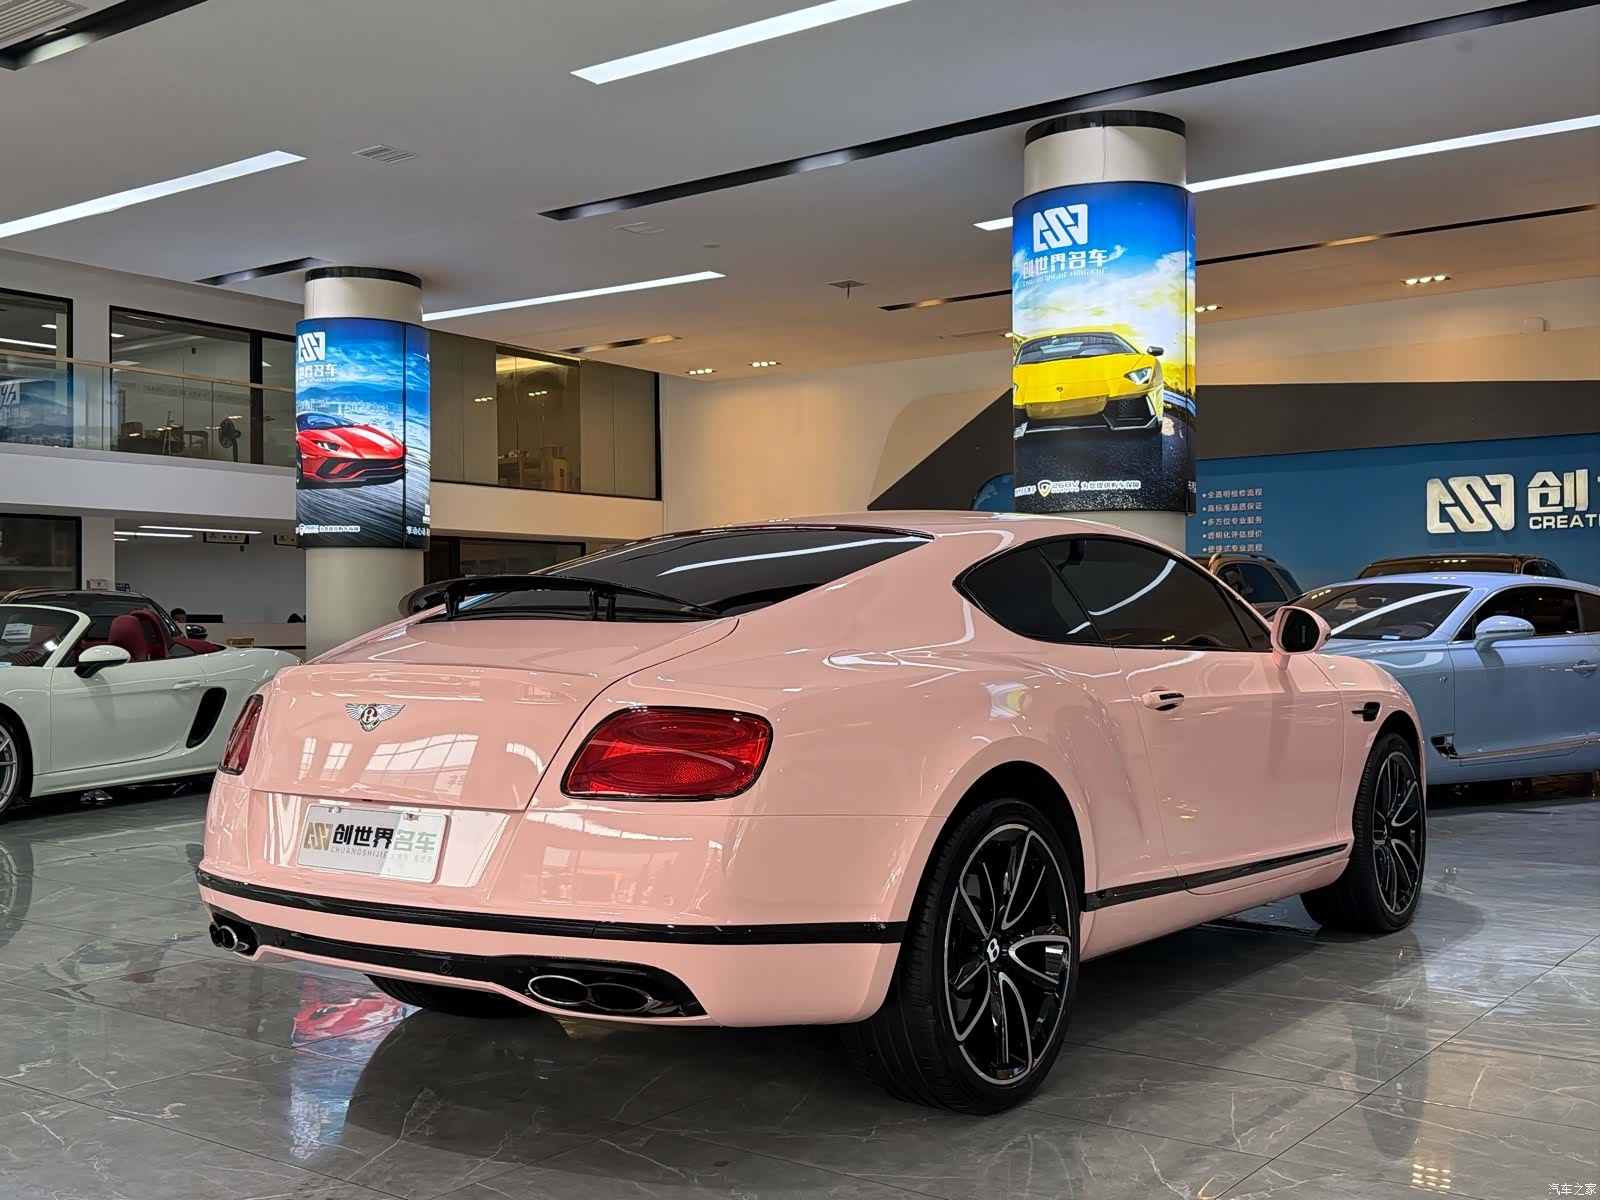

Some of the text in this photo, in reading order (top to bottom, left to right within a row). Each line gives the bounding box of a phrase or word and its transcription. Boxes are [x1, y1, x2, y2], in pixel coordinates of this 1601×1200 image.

[1023, 249, 1108, 279] 创世界名车
[1528, 469, 1600, 514] 创
[1529, 514, 1601, 530] CREAT
[330, 845, 388, 859] CHUANGSHIJIE
[332, 823, 437, 853] 创世界名车
